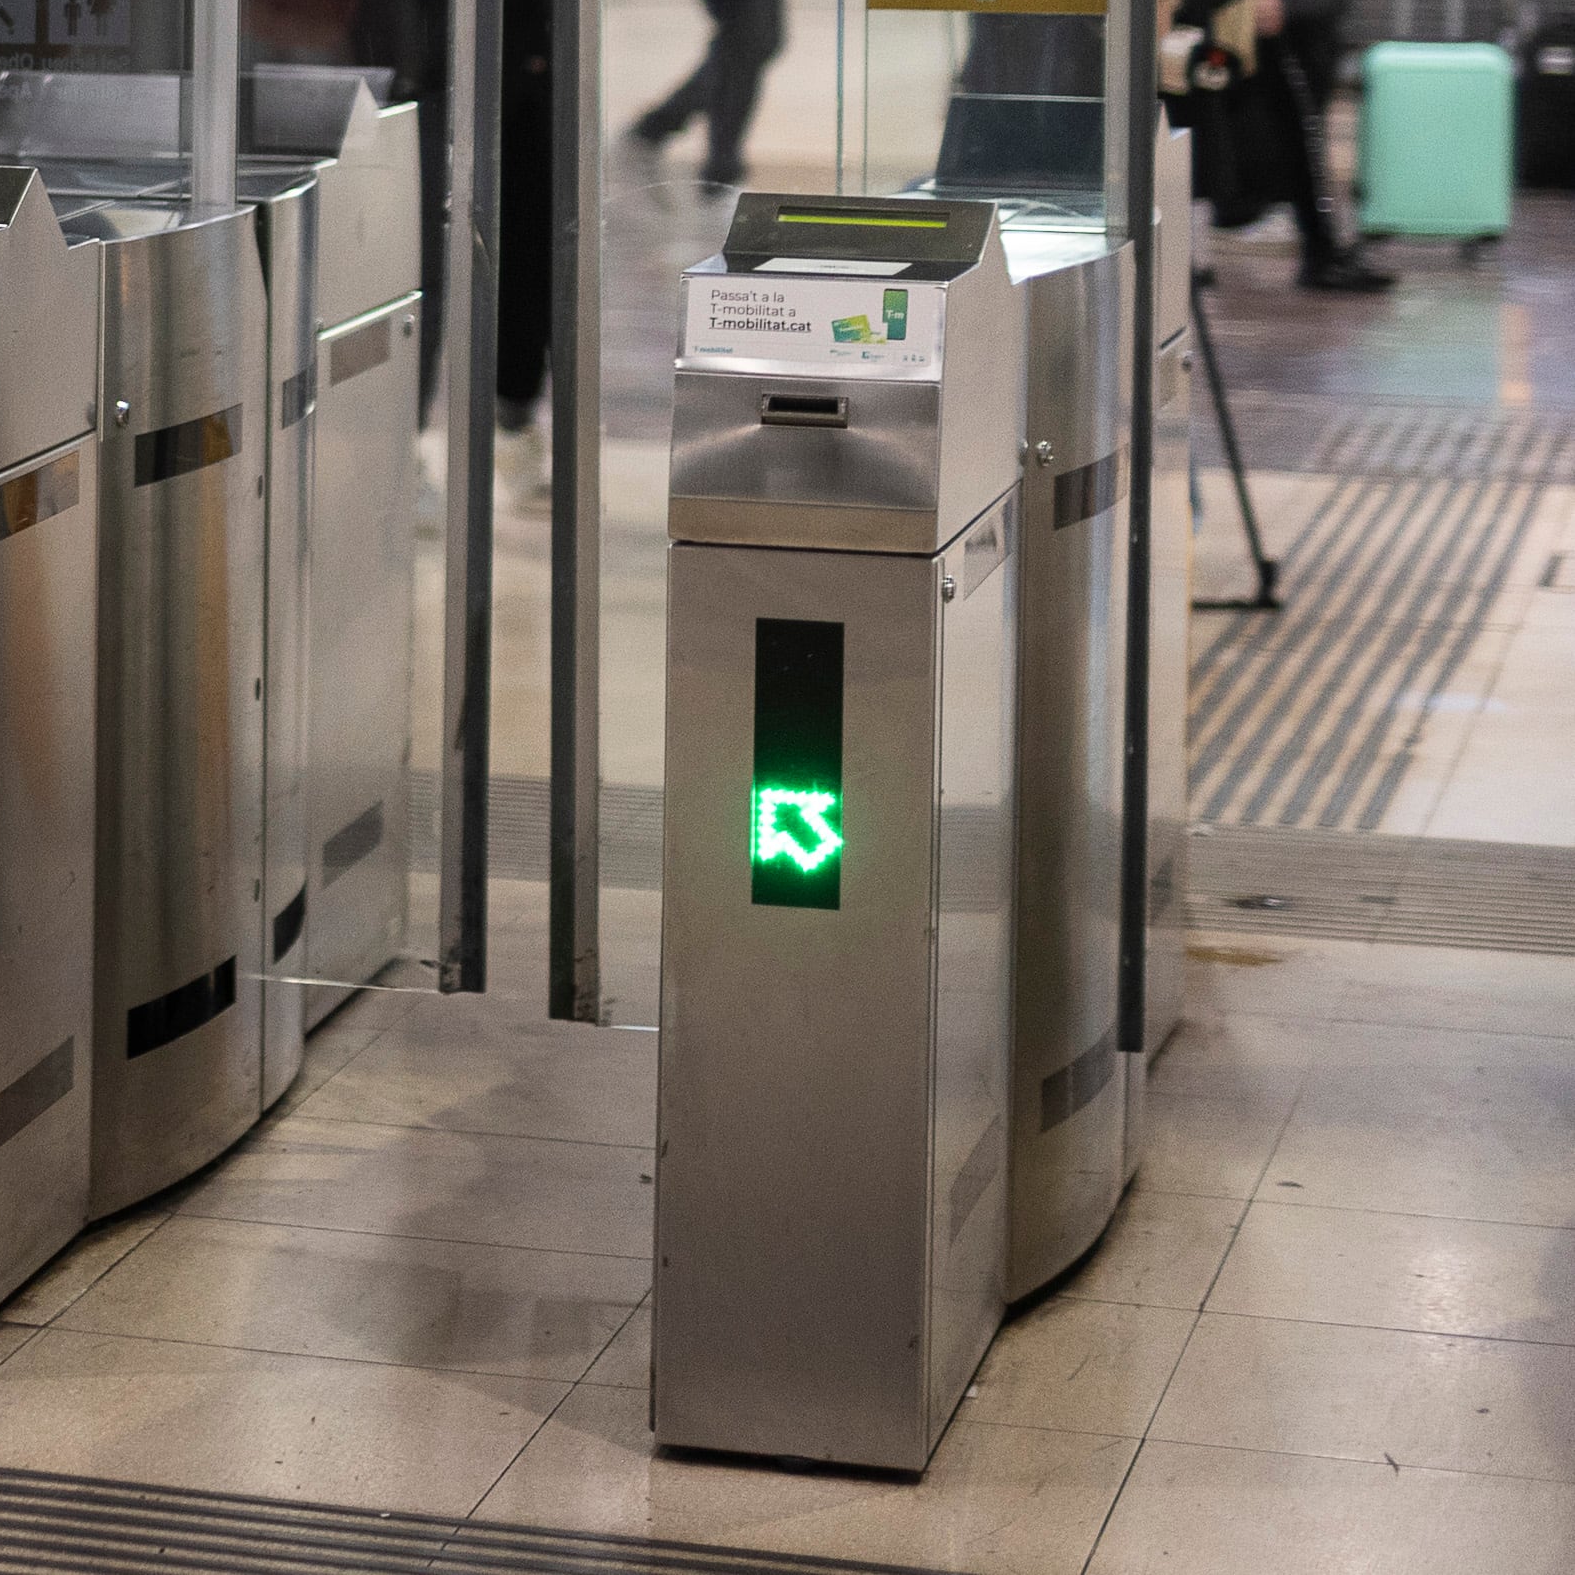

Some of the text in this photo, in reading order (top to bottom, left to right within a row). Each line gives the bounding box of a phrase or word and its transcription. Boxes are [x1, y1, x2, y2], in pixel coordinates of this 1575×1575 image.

[710, 289, 785, 303] Passa't a la
[710, 303, 796, 318] T-mobilitat a
[708, 317, 812, 333] T-mobilitat.cat
